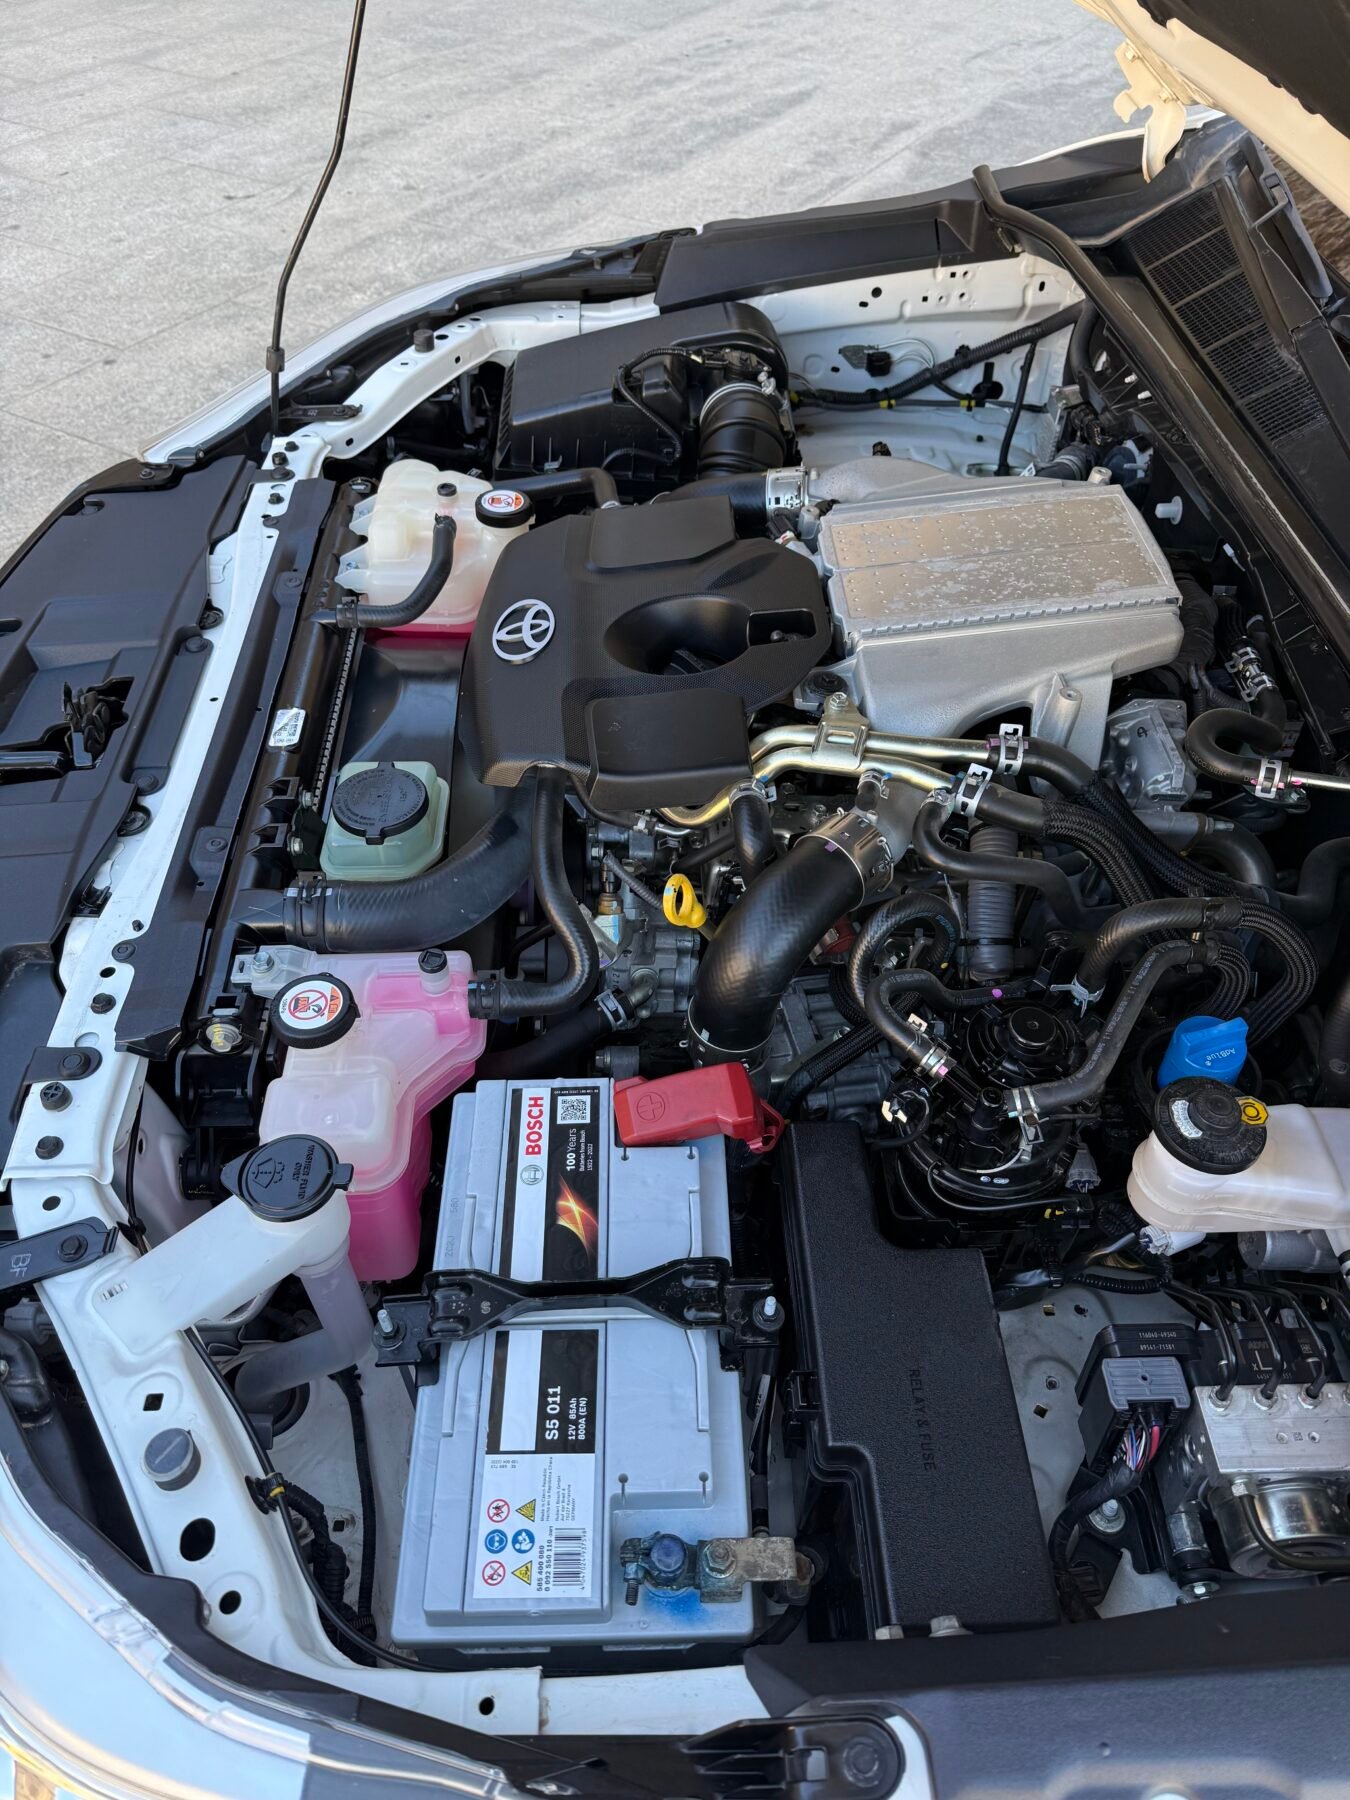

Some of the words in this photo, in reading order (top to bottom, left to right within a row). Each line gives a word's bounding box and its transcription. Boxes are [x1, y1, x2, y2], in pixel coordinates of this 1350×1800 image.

[525, 1097, 544, 1156] BOSCH
[567, 1128, 576, 1152] Years
[302, 1144, 315, 1176] WASHER
[566, 1153, 576, 1171] 100
[292, 1162, 302, 1182] ONLY
[298, 1178, 308, 1200] FLUID
[547, 1386, 560, 1414] 011
[908, 1369, 926, 1412] RELAY
[569, 1398, 577, 1419] 85Ah
[579, 1398, 588, 1415] (EN)
[545, 1420, 559, 1440] S5
[568, 1424, 576, 1440] 12V
[916, 1419, 928, 1427] &
[919, 1434, 936, 1471] FUSE
